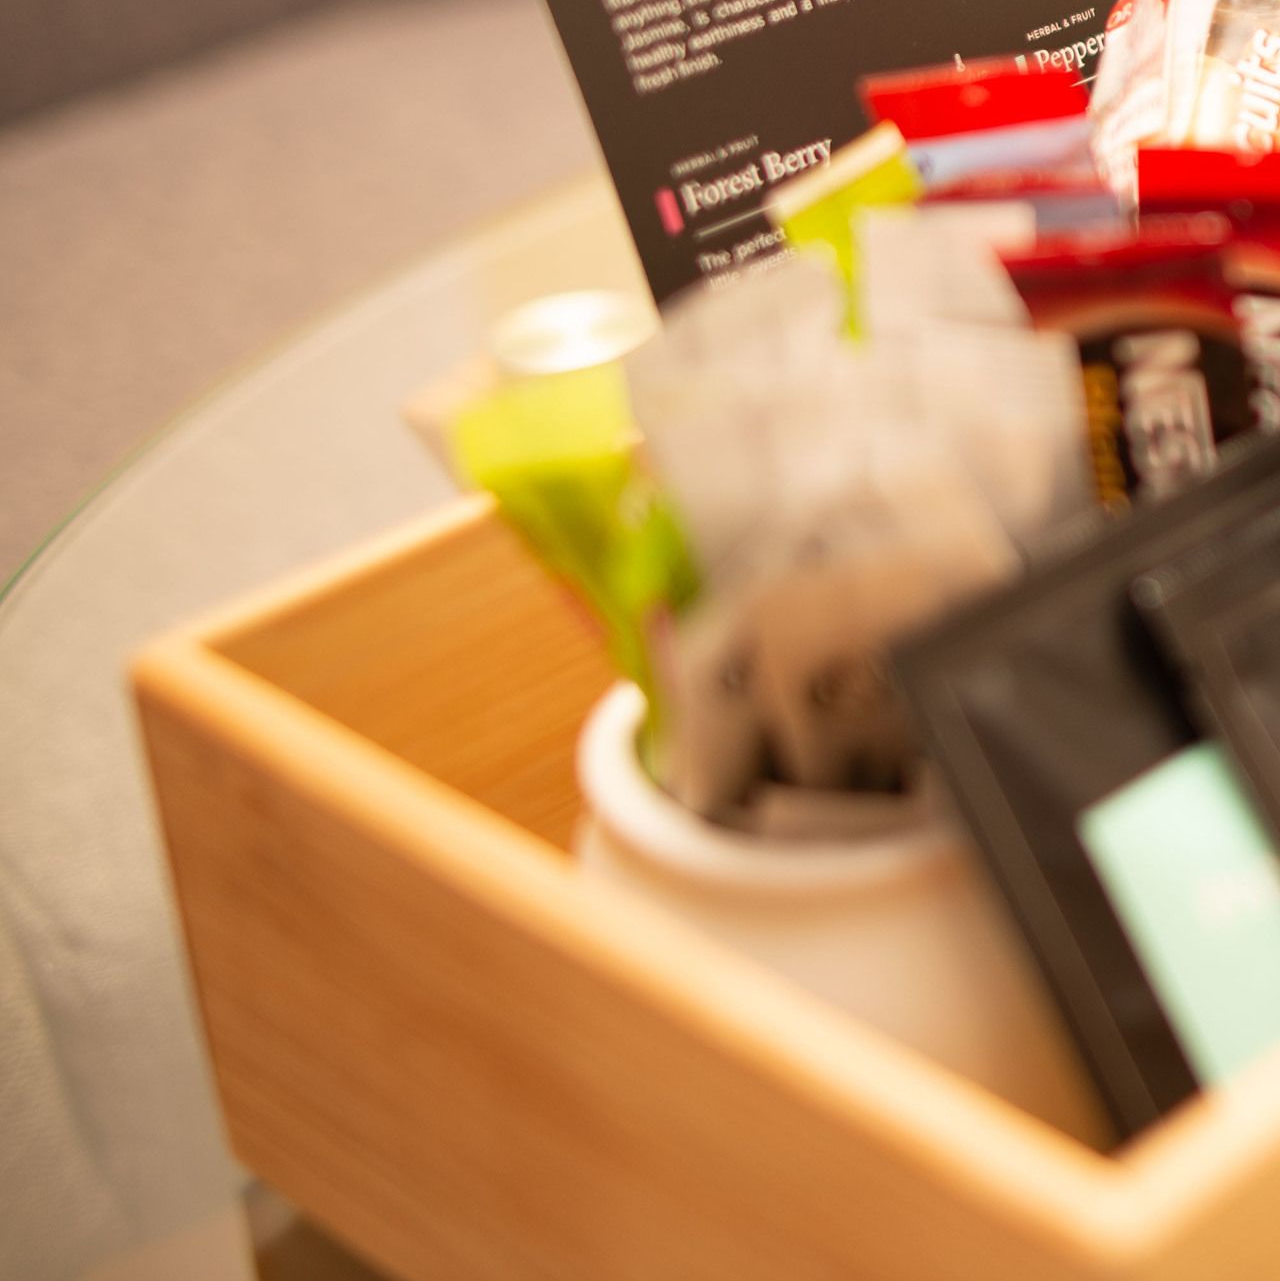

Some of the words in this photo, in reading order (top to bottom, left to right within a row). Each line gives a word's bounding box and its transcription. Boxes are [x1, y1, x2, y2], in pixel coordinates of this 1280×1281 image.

[1027, 22, 1063, 41] HERBAL
[1063, 19, 1071, 28] &
[1070, 8, 1096, 24] FRUIT
[681, 164, 765, 213] Forest
[761, 139, 844, 182] Berry
